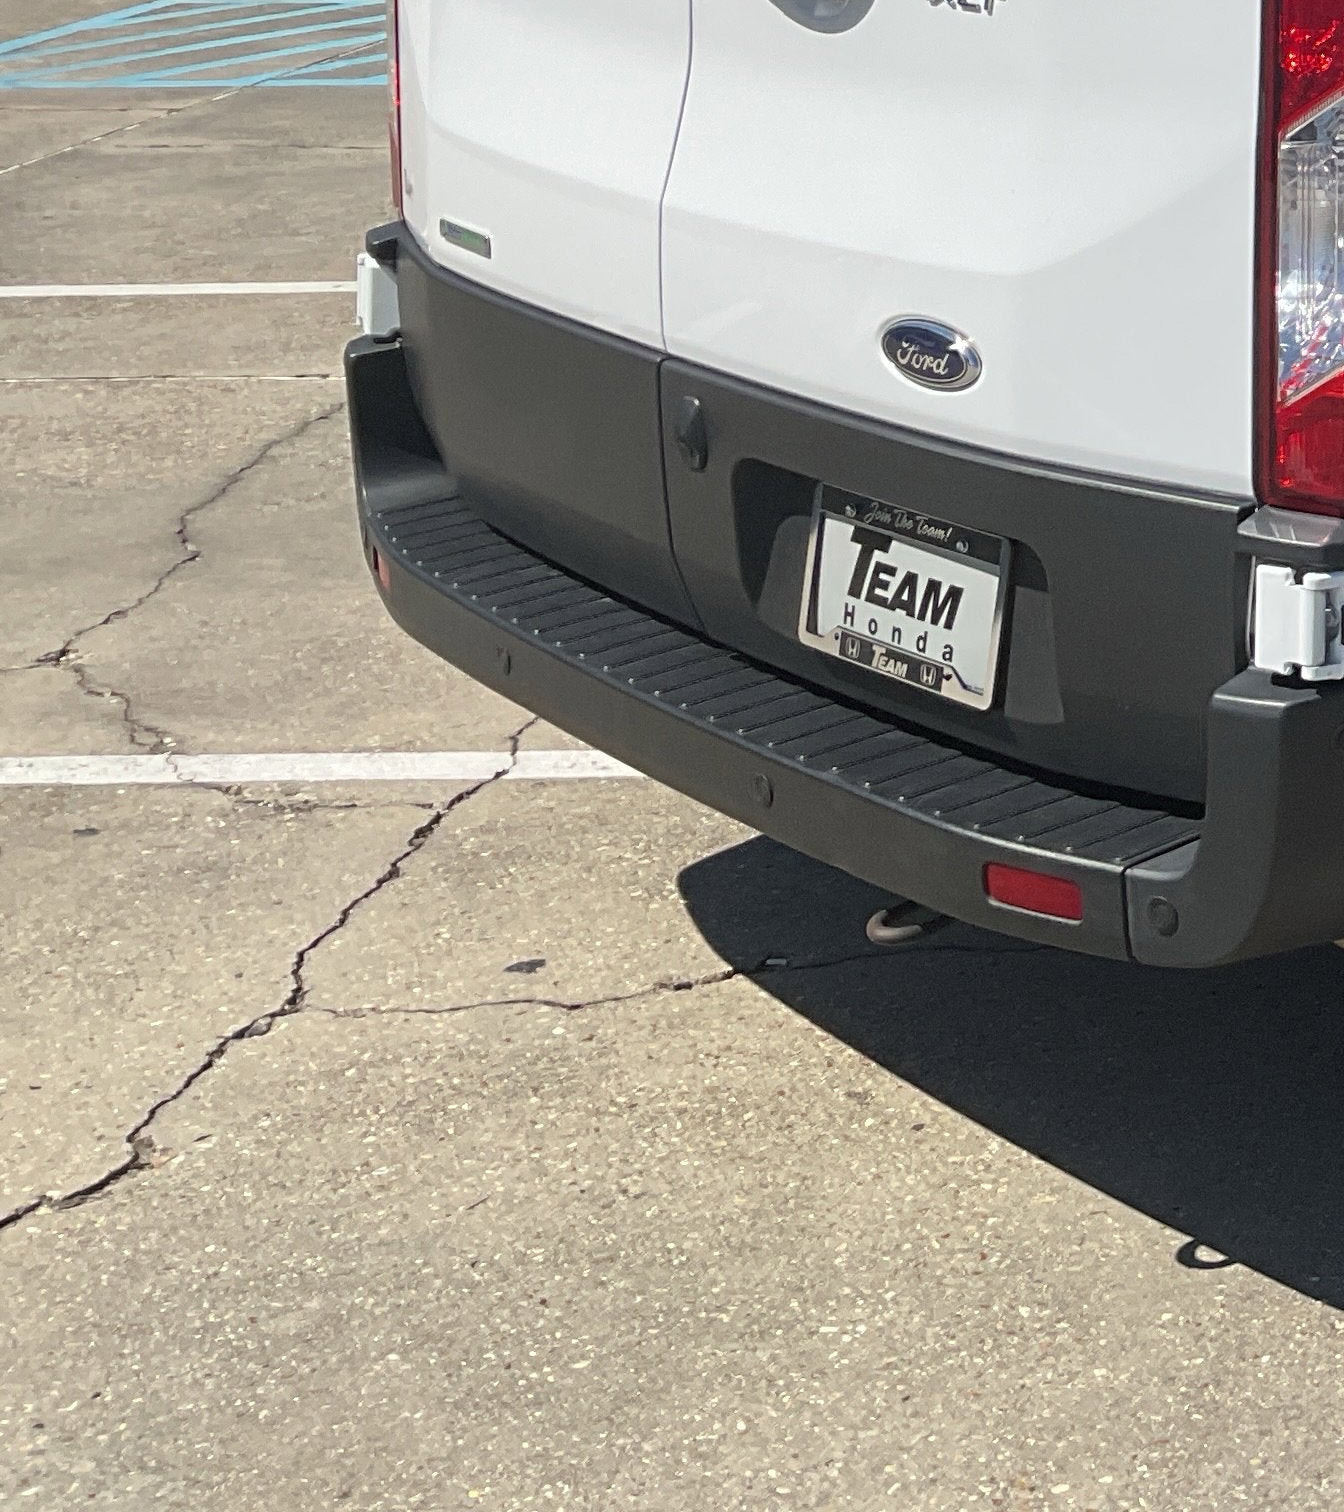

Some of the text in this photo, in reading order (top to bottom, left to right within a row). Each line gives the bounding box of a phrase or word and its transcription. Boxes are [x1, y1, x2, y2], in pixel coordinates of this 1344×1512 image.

[896, 340, 950, 376] Ford
[863, 501, 892, 525] Join
[893, 508, 914, 530] The
[847, 525, 965, 631] TEAM
[843, 602, 954, 663] Honda
[871, 643, 909, 678] TEAM
